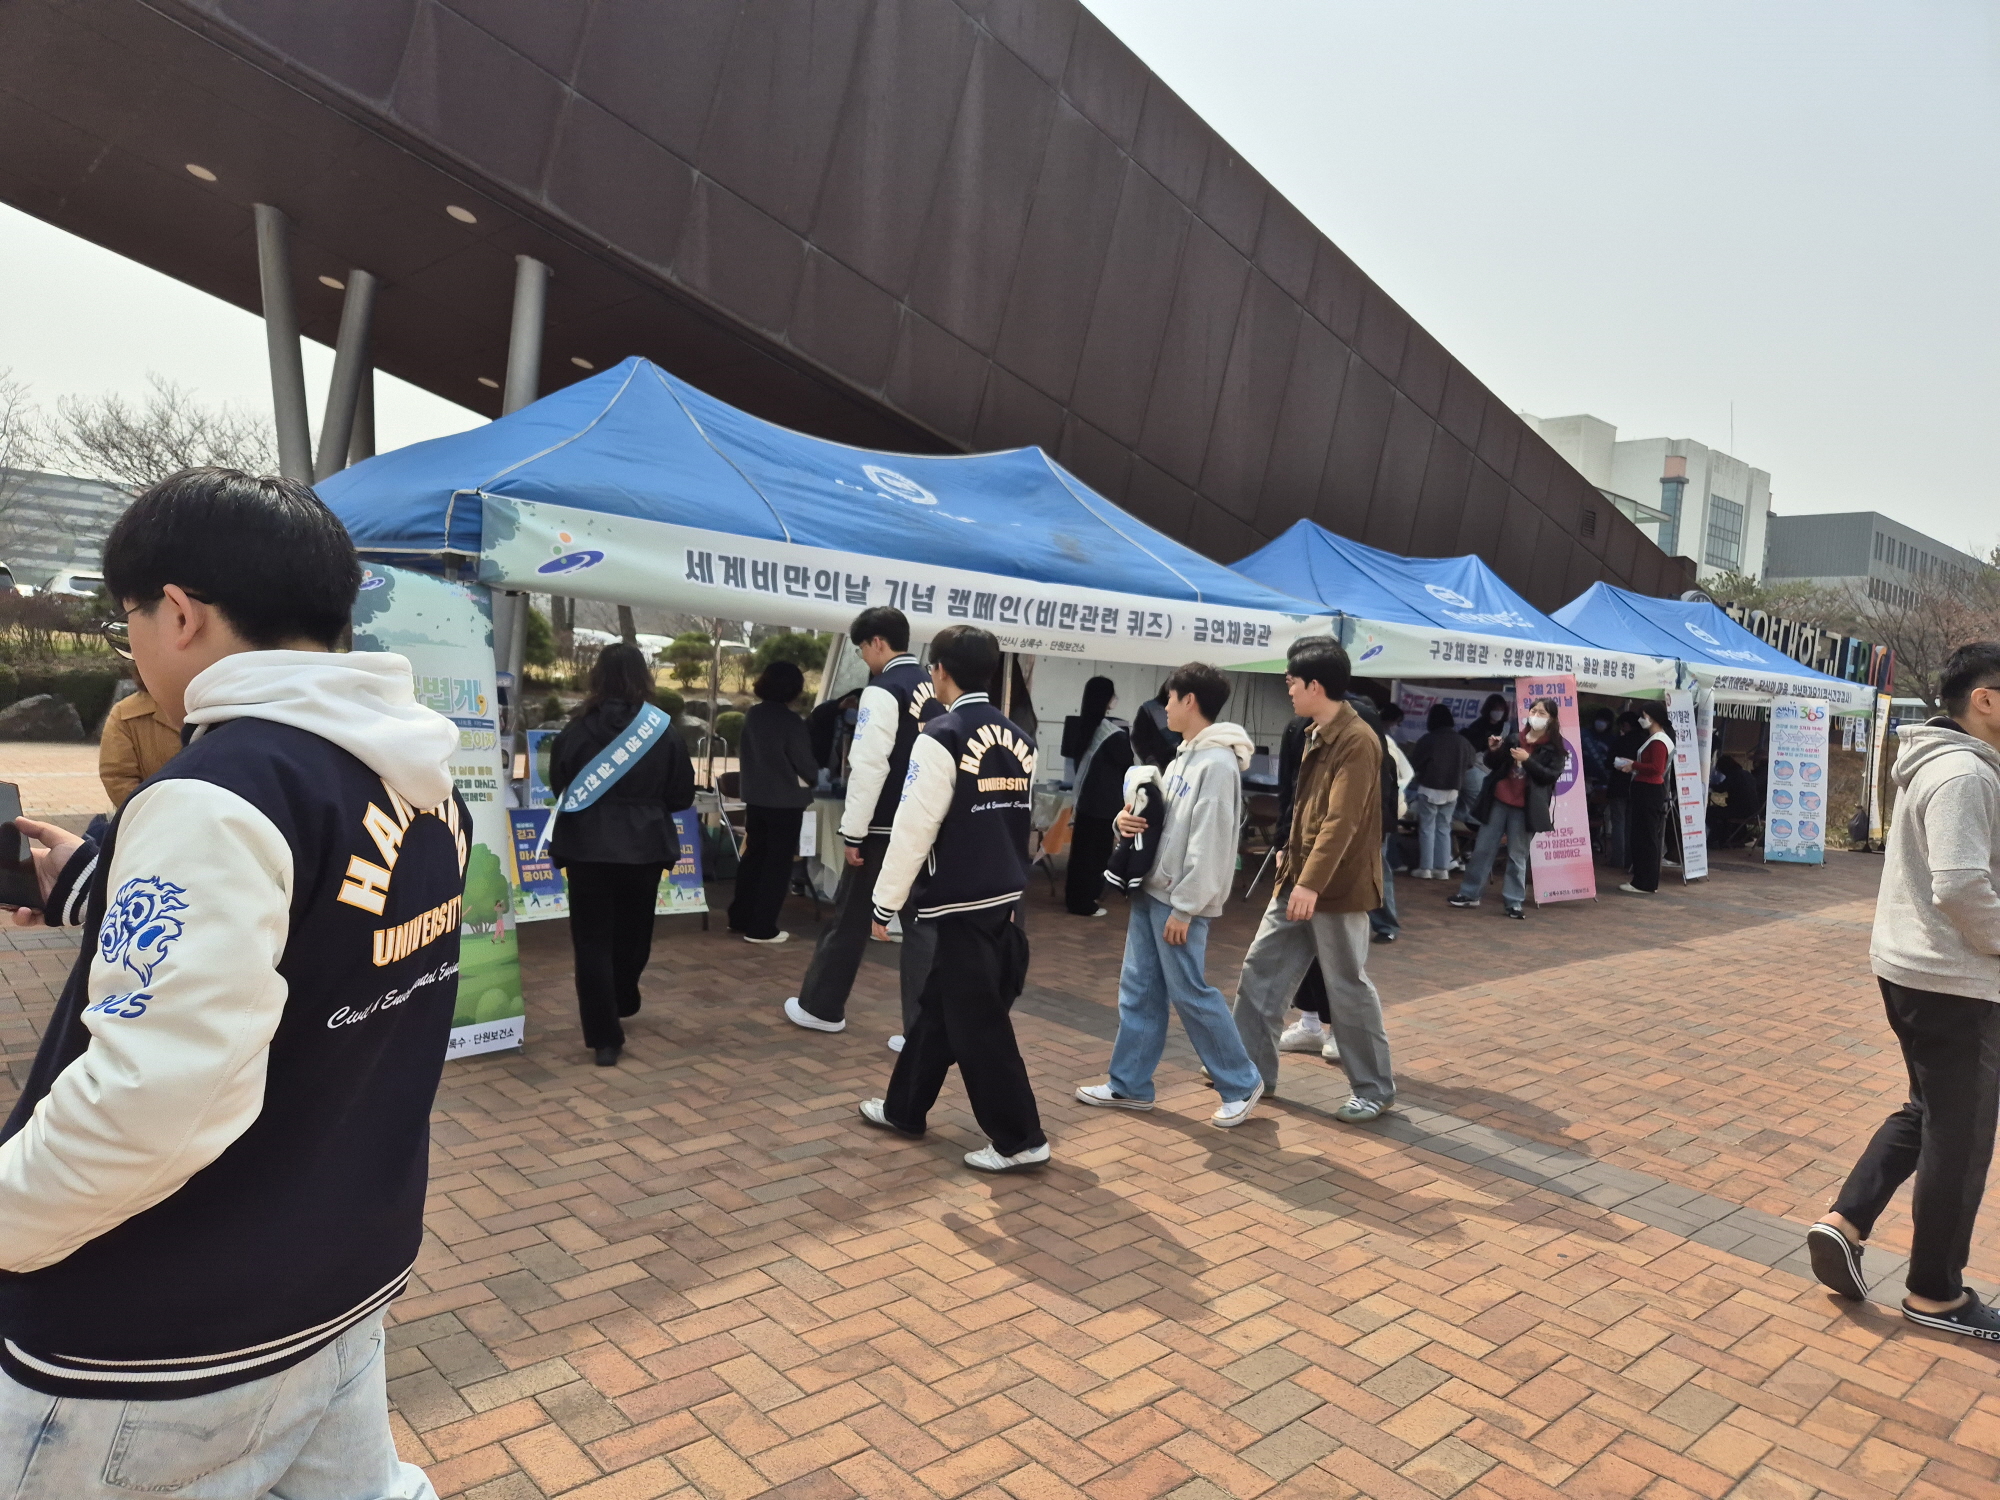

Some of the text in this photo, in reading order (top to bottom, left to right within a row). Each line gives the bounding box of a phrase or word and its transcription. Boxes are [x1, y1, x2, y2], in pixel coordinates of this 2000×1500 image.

[685, 549, 1272, 648] 세계비만의날 기념 캠페인(비만관련 퀴즈) 금연체험관
[1049, 640, 1085, 653] 단원보건소
[1429, 640, 1489, 664] 구강체험관
[1503, 648, 1573, 672] 유방암자가검진
[1528, 684, 1544, 696] 3월
[1546, 683, 1566, 694] 21일
[1564, 696, 1573, 707] 날
[1799, 705, 1825, 722] 365
[960, 723, 1034, 776] HANYANG
[977, 777, 1028, 792] UNIVERSITY
[336, 778, 468, 917] HANNG
[372, 893, 463, 968] UNIVERSITY
[449, 1027, 514, 1049] 록수 단원보건소
